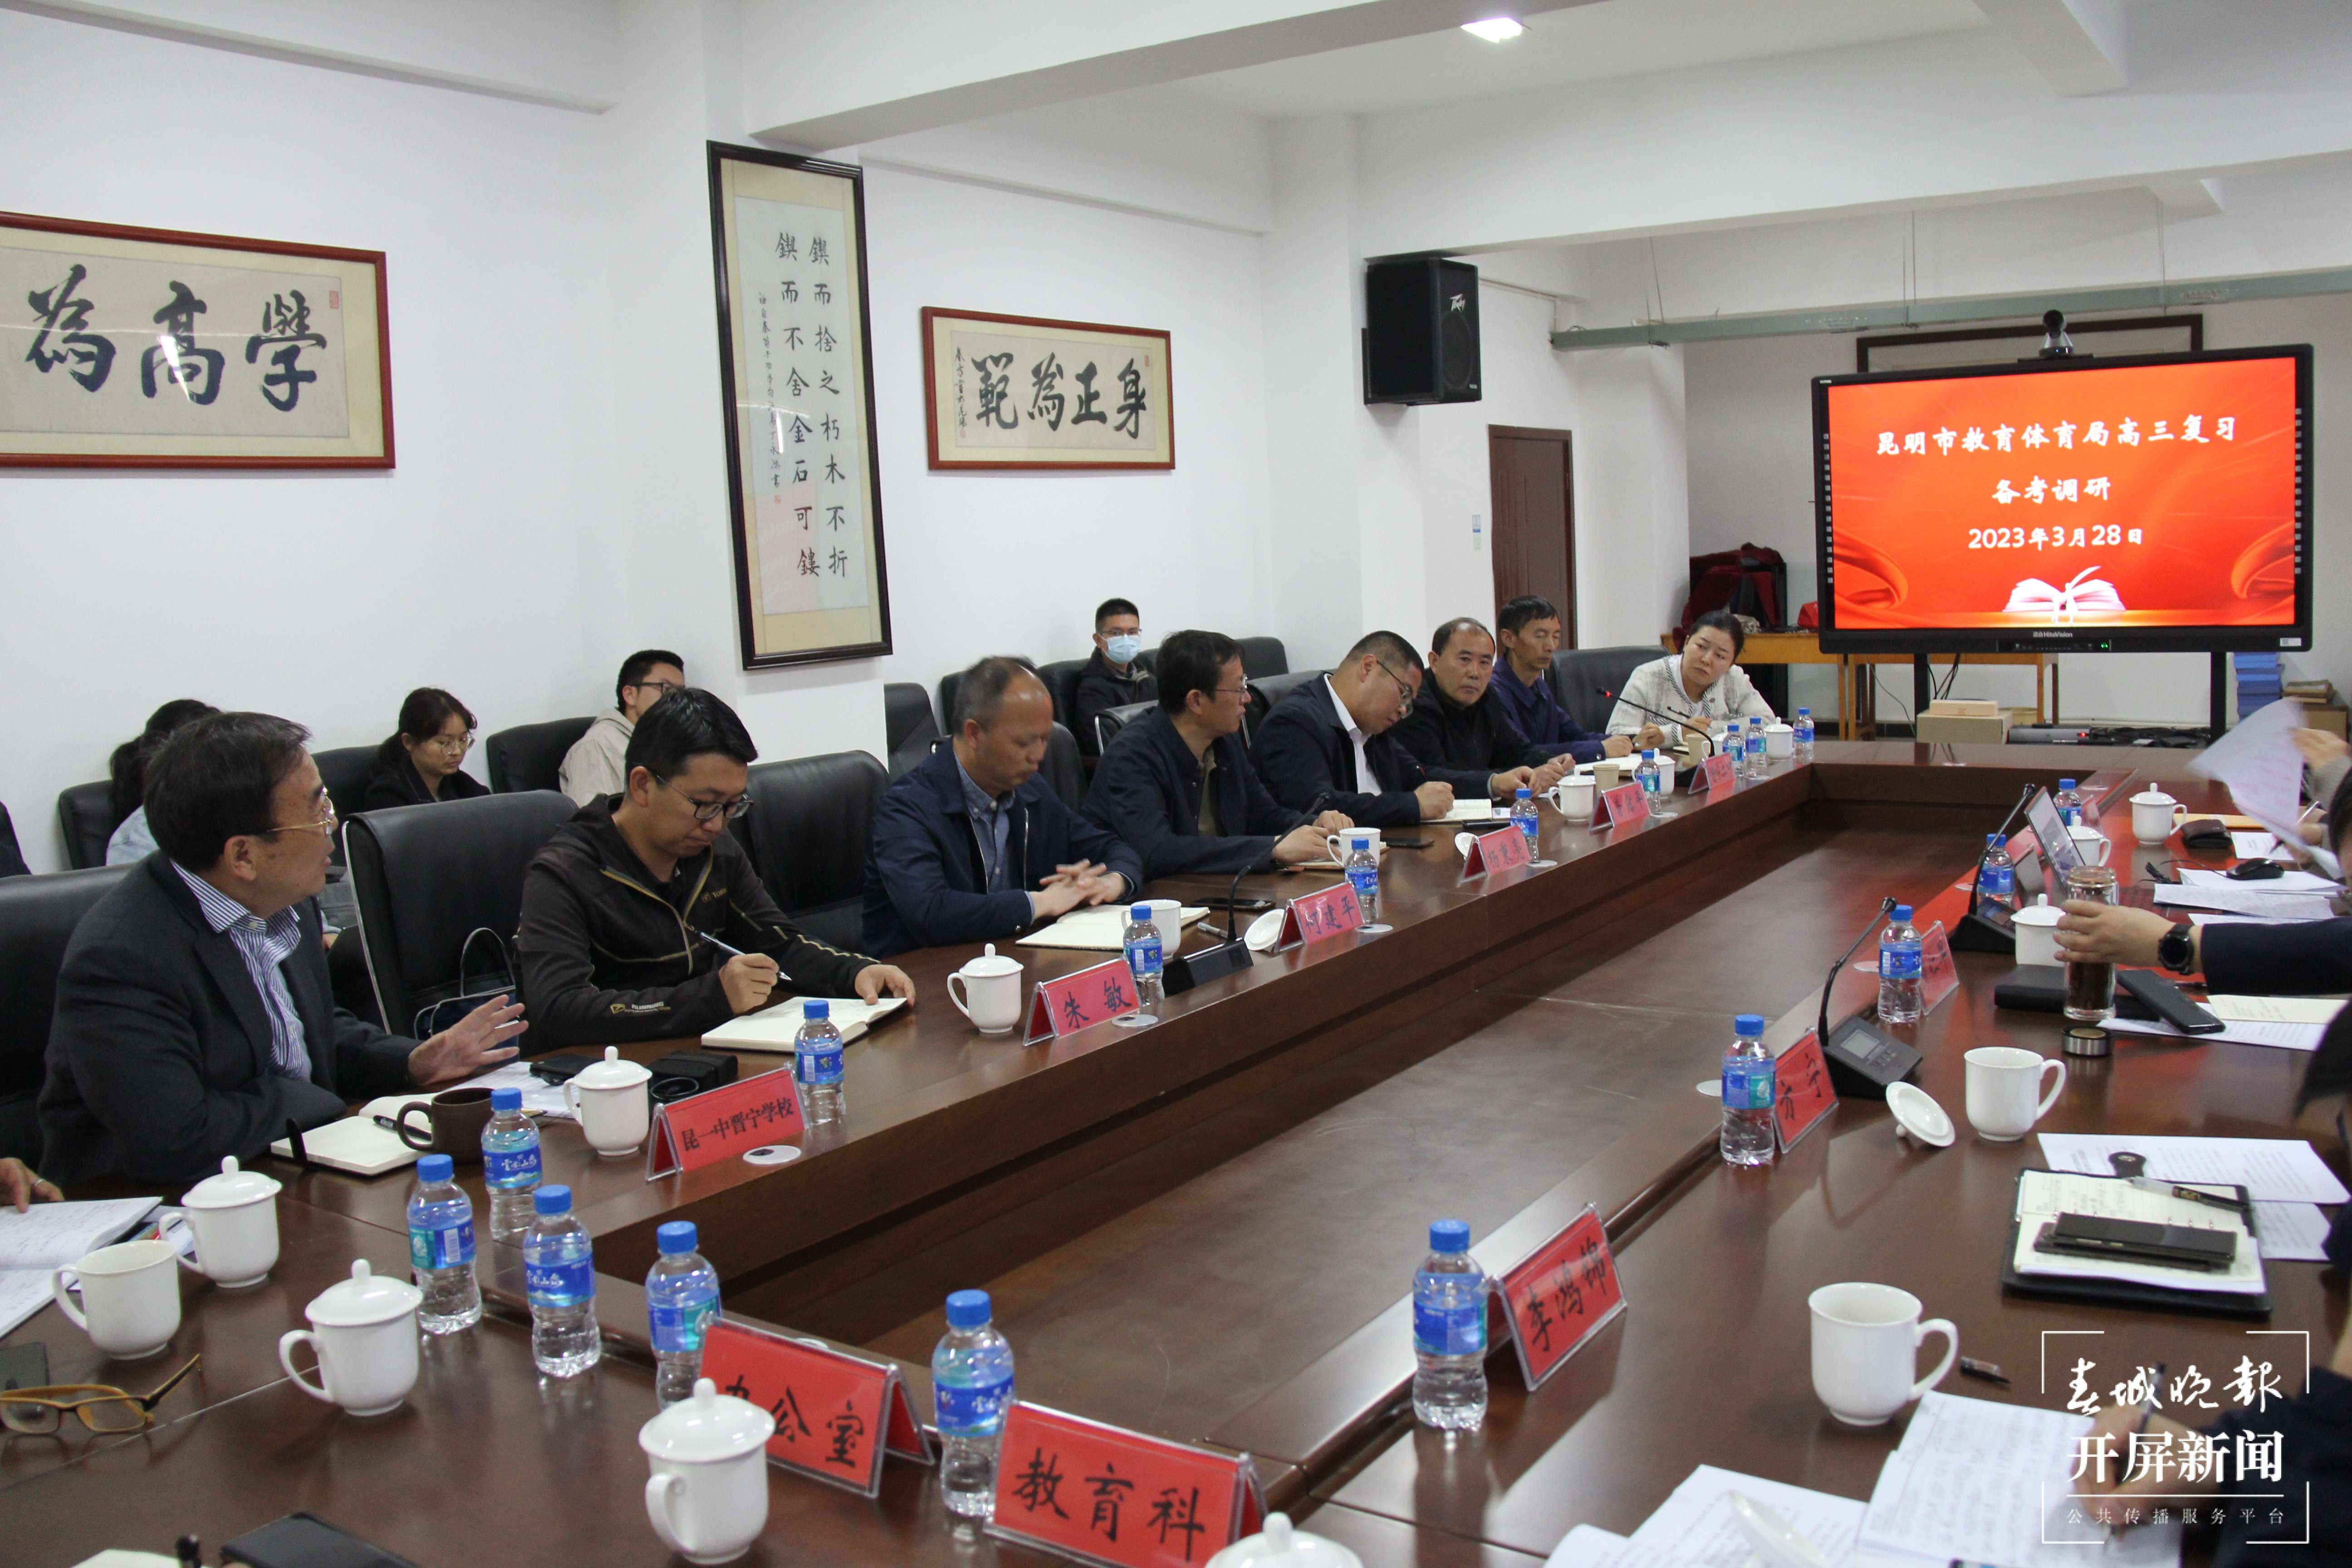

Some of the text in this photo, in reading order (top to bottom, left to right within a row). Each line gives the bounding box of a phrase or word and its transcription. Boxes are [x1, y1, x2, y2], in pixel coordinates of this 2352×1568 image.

[1877, 414, 2236, 456] 昆明市教育体育局高三复习
[1991, 475, 2111, 505] 备考调研
[1968, 524, 2143, 550] 2023年3月28日
[1064, 977, 1132, 1029] 朱敏
[681, 1098, 794, 1152] 昆一中晋宁学校
[1012, 1447, 1205, 1563] 教育科
